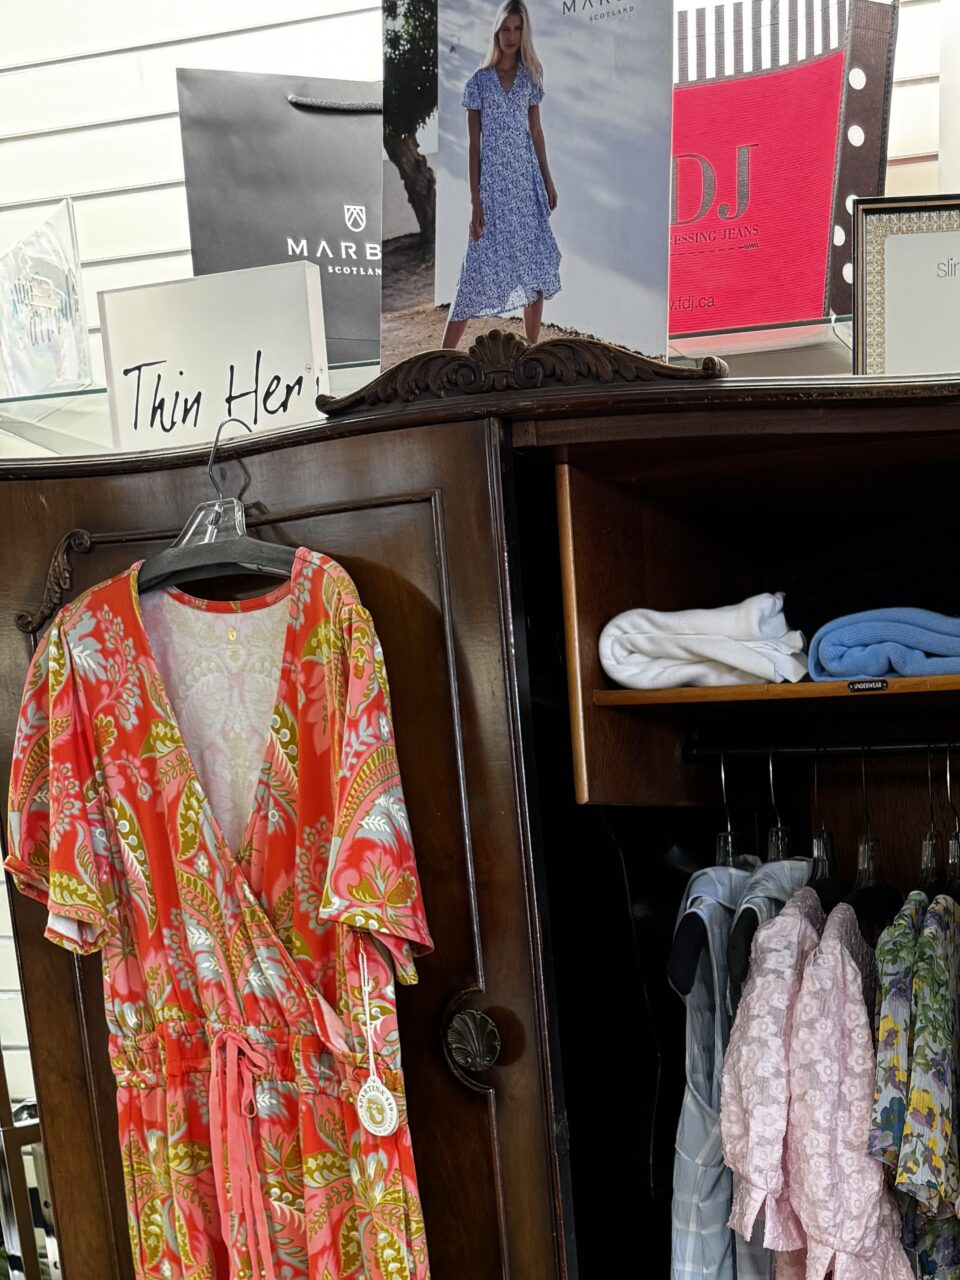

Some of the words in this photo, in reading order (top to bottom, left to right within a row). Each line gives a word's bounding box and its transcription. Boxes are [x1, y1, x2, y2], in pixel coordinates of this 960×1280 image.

[589, 5, 635, 21] SCOTLAND
[721, 224, 760, 242] JEANS
[286, 237, 382, 261] MARB
[122, 359, 203, 433] Thin
[225, 349, 304, 426] Her
